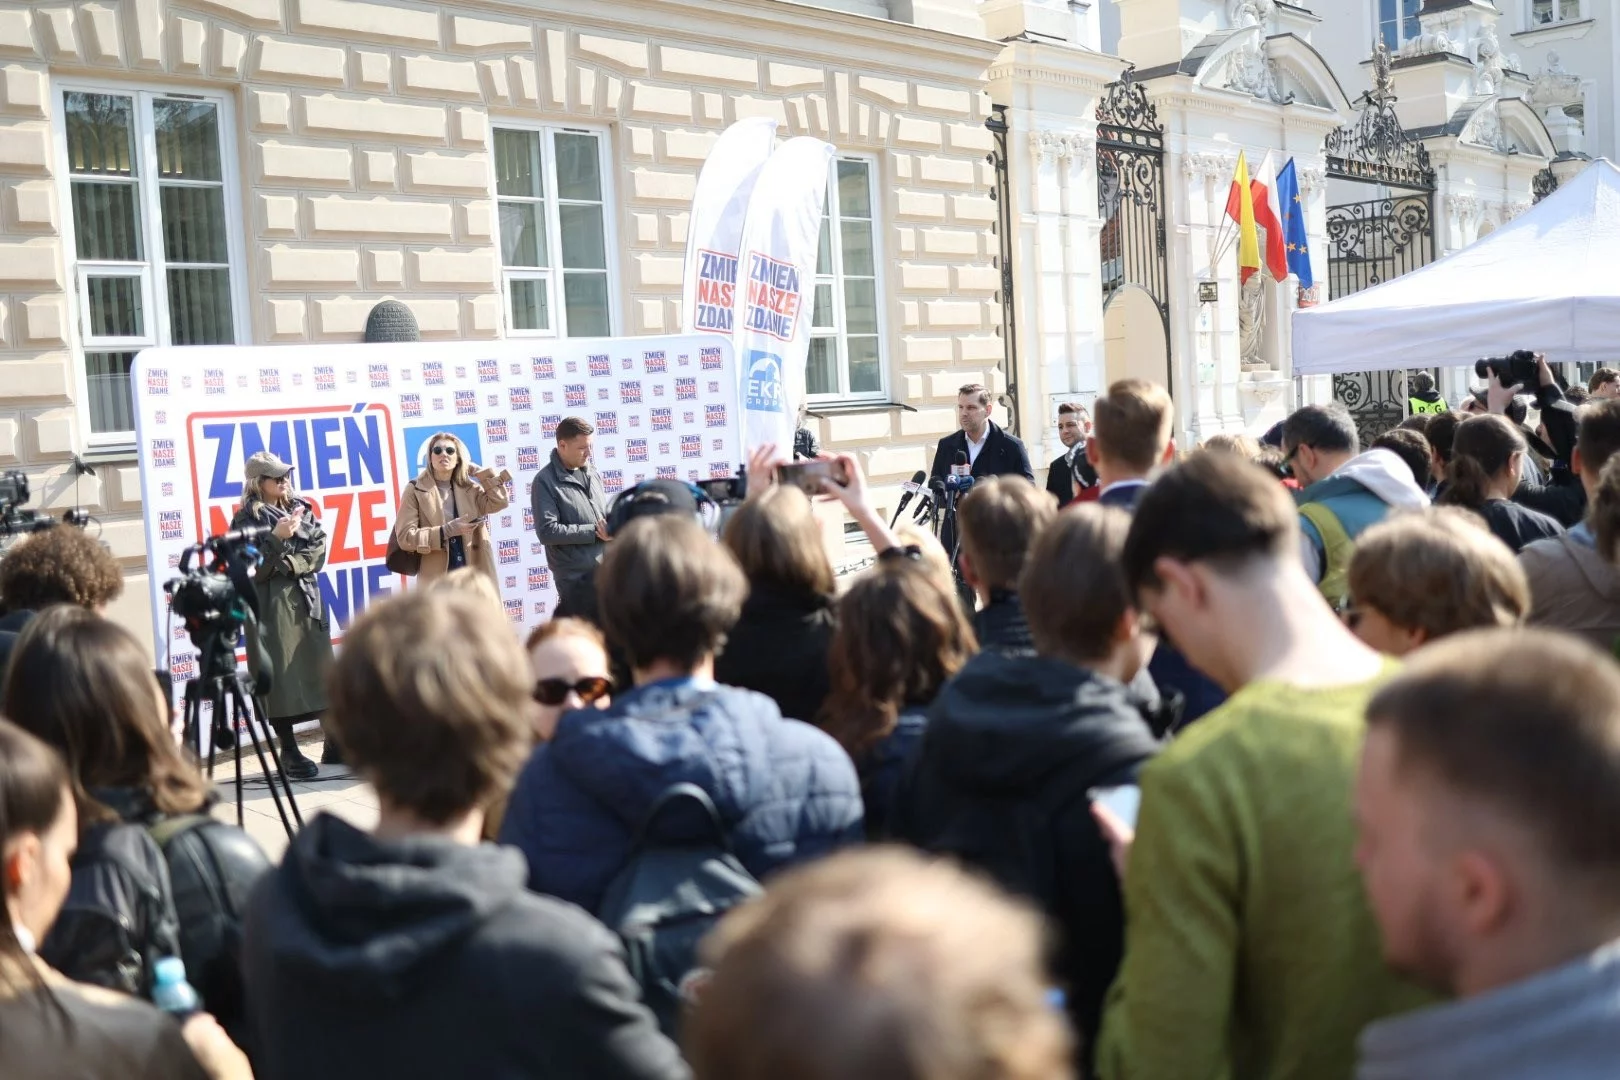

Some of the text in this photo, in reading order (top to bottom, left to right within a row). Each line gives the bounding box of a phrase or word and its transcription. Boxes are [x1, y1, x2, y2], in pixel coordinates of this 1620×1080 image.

[700, 253, 737, 284] ZMIE
[699, 279, 736, 308] NAS
[748, 280, 797, 317] NASZE
[746, 304, 792, 338] ZDANIE
[314, 374, 334, 382] NASZE
[369, 372, 388, 380] NASZE
[148, 378, 168, 386] NASZE
[510, 395, 530, 403] NASZE
[748, 398, 781, 406] GRUP
[402, 402, 420, 410] NASZE
[458, 406, 476, 414] ZDANIE
[203, 402, 384, 499] ZMIEŃ
[628, 447, 646, 455] NASZE
[682, 443, 700, 451] NASZE
[153, 449, 174, 458] NASZE
[154, 458, 175, 466] ZDANIE
[518, 455, 538, 463] NASZE
[603, 478, 622, 486] NASZE
[160, 521, 182, 530] NASZE
[162, 530, 182, 539] ZDANIE
[530, 582, 548, 590] ZDANIE
[172, 662, 192, 672] NASZE
[174, 671, 194, 682] ZDANIE
